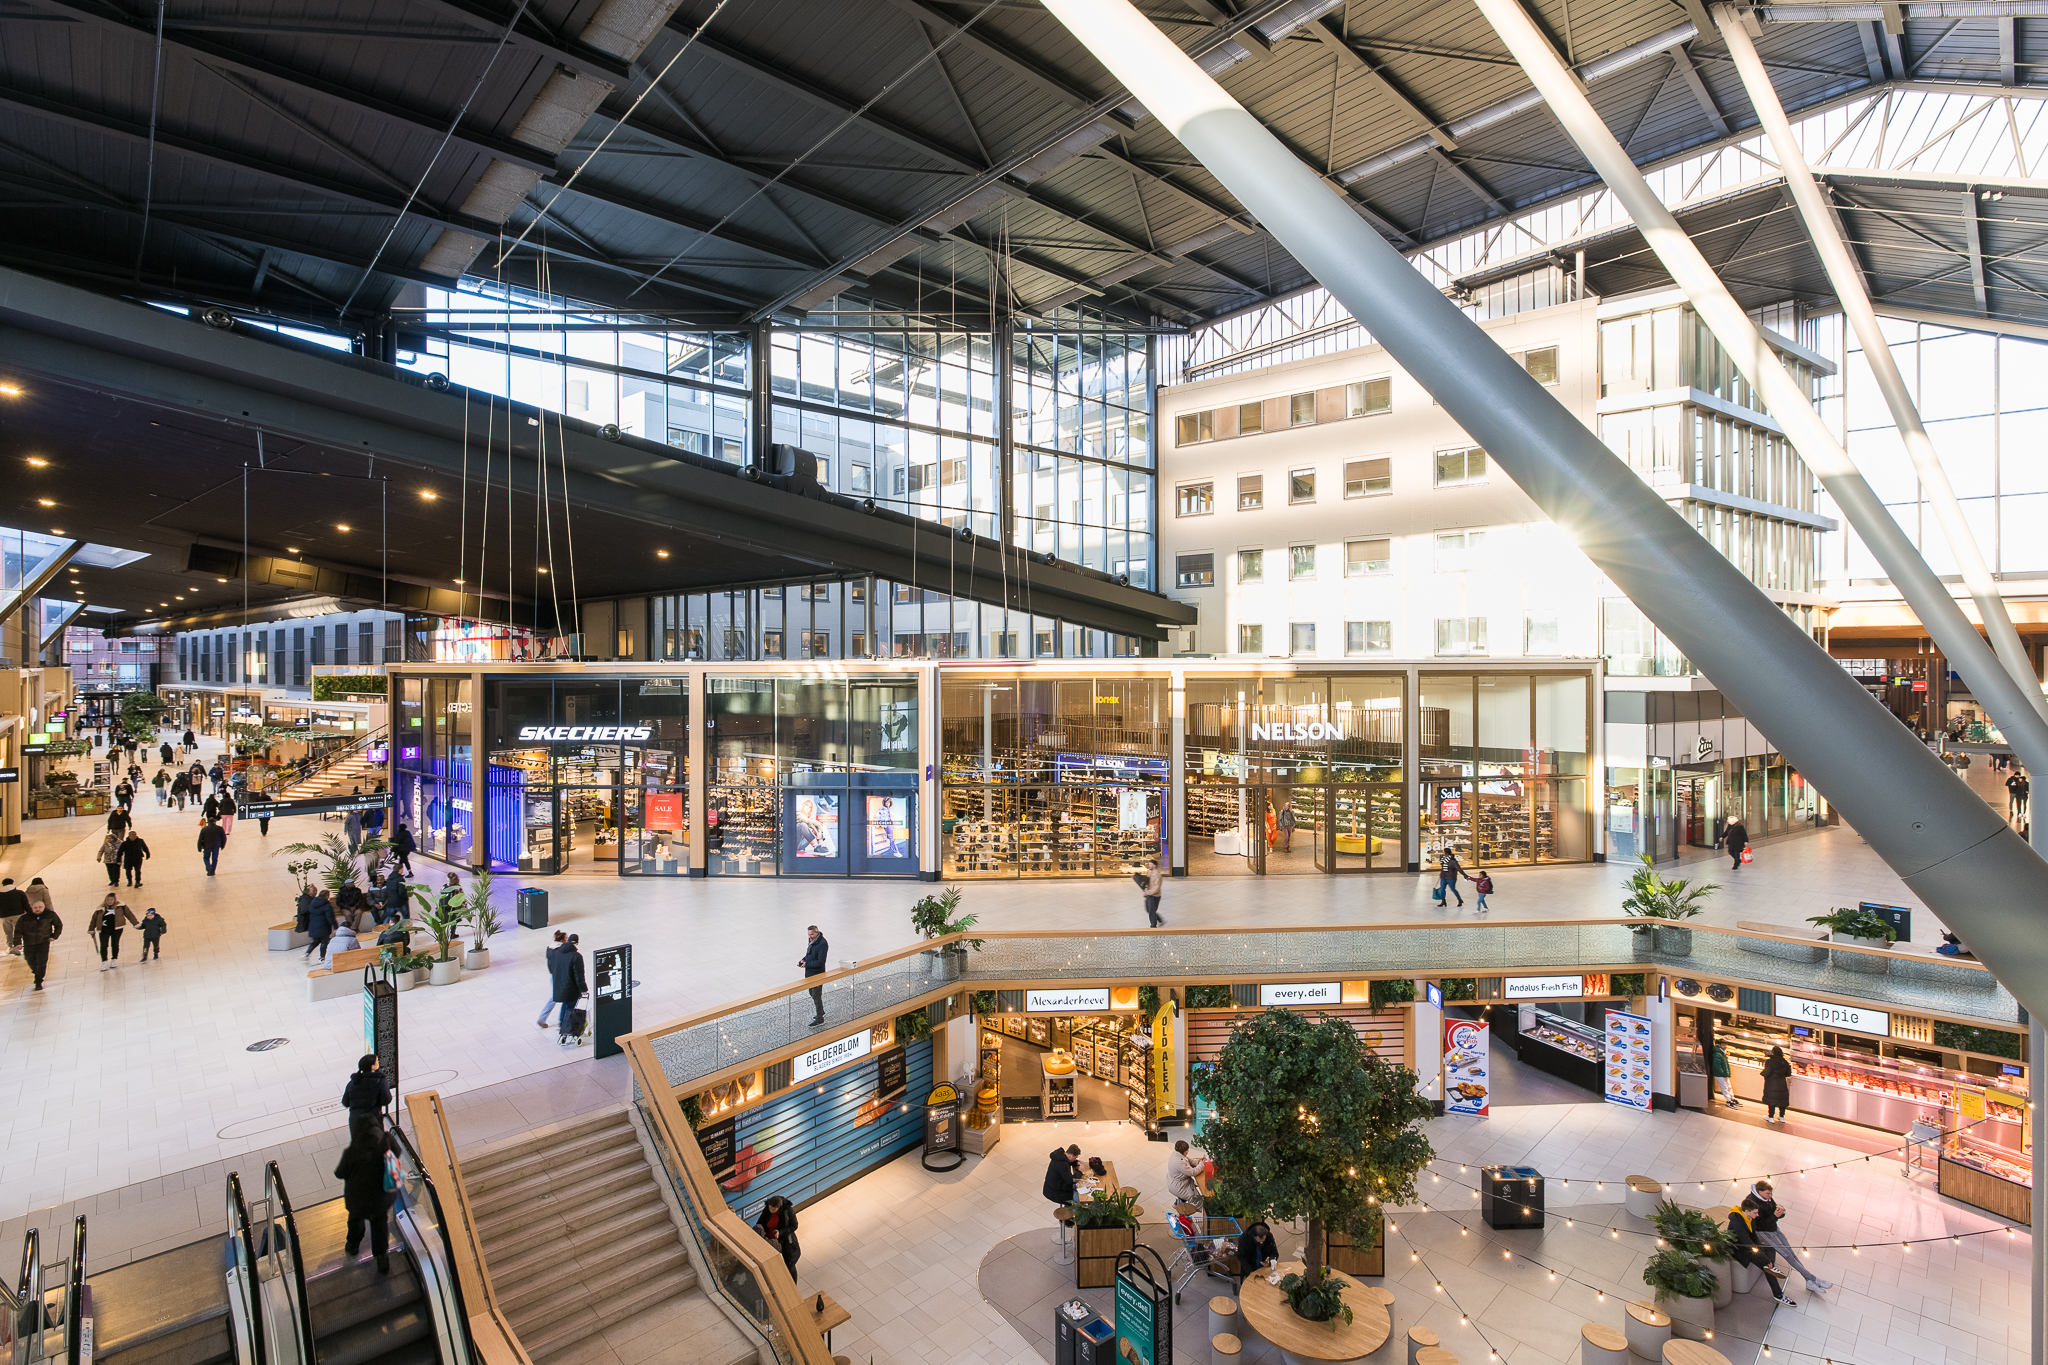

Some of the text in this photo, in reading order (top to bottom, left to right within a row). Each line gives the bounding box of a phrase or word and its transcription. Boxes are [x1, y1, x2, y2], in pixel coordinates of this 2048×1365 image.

[518, 726, 652, 741] SKECHERS
[1252, 722, 1345, 741] NELSON
[1092, 759, 1125, 768] NELSON
[1440, 787, 1461, 799] Sale
[654, 805, 673, 813] SALE
[1442, 809, 1460, 818] 50%
[1425, 836, 1454, 852] sale
[1509, 982, 1578, 992] Andalus Fresh Fish
[1275, 988, 1327, 999] every.deli
[1031, 995, 1105, 1007] Alexanderhoeve
[1802, 1003, 1859, 1024] kippie
[806, 1037, 860, 1067] GELDERBLOM
[935, 1090, 950, 1098] kaas
[1120, 1289, 1148, 1313] every.deli
